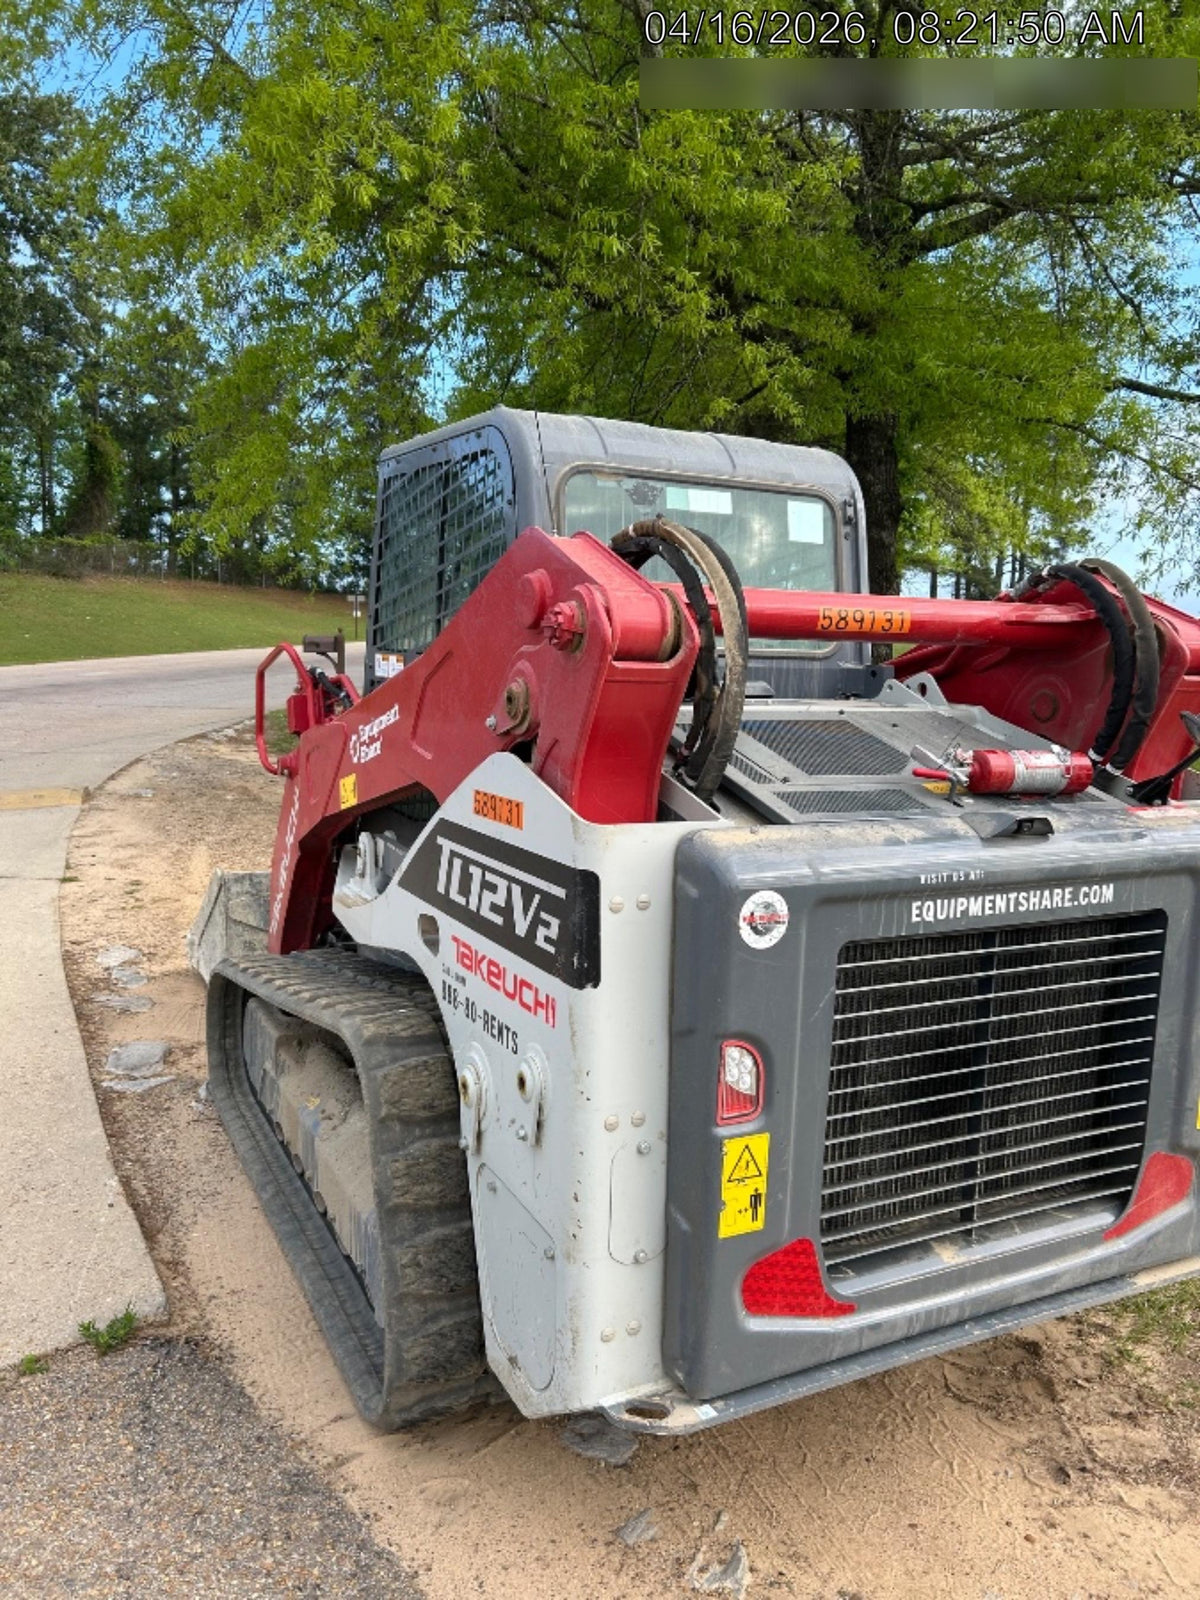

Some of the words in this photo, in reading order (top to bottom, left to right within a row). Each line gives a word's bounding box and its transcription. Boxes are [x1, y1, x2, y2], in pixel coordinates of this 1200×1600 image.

[820, 607, 905, 632] 589131
[473, 790, 521, 828] 589131
[436, 835, 567, 955] TL12V2
[920, 872, 948, 885] VISIT
[952, 871, 965, 882] US
[911, 883, 1115, 923] EQUIPMENTSHARE.COM
